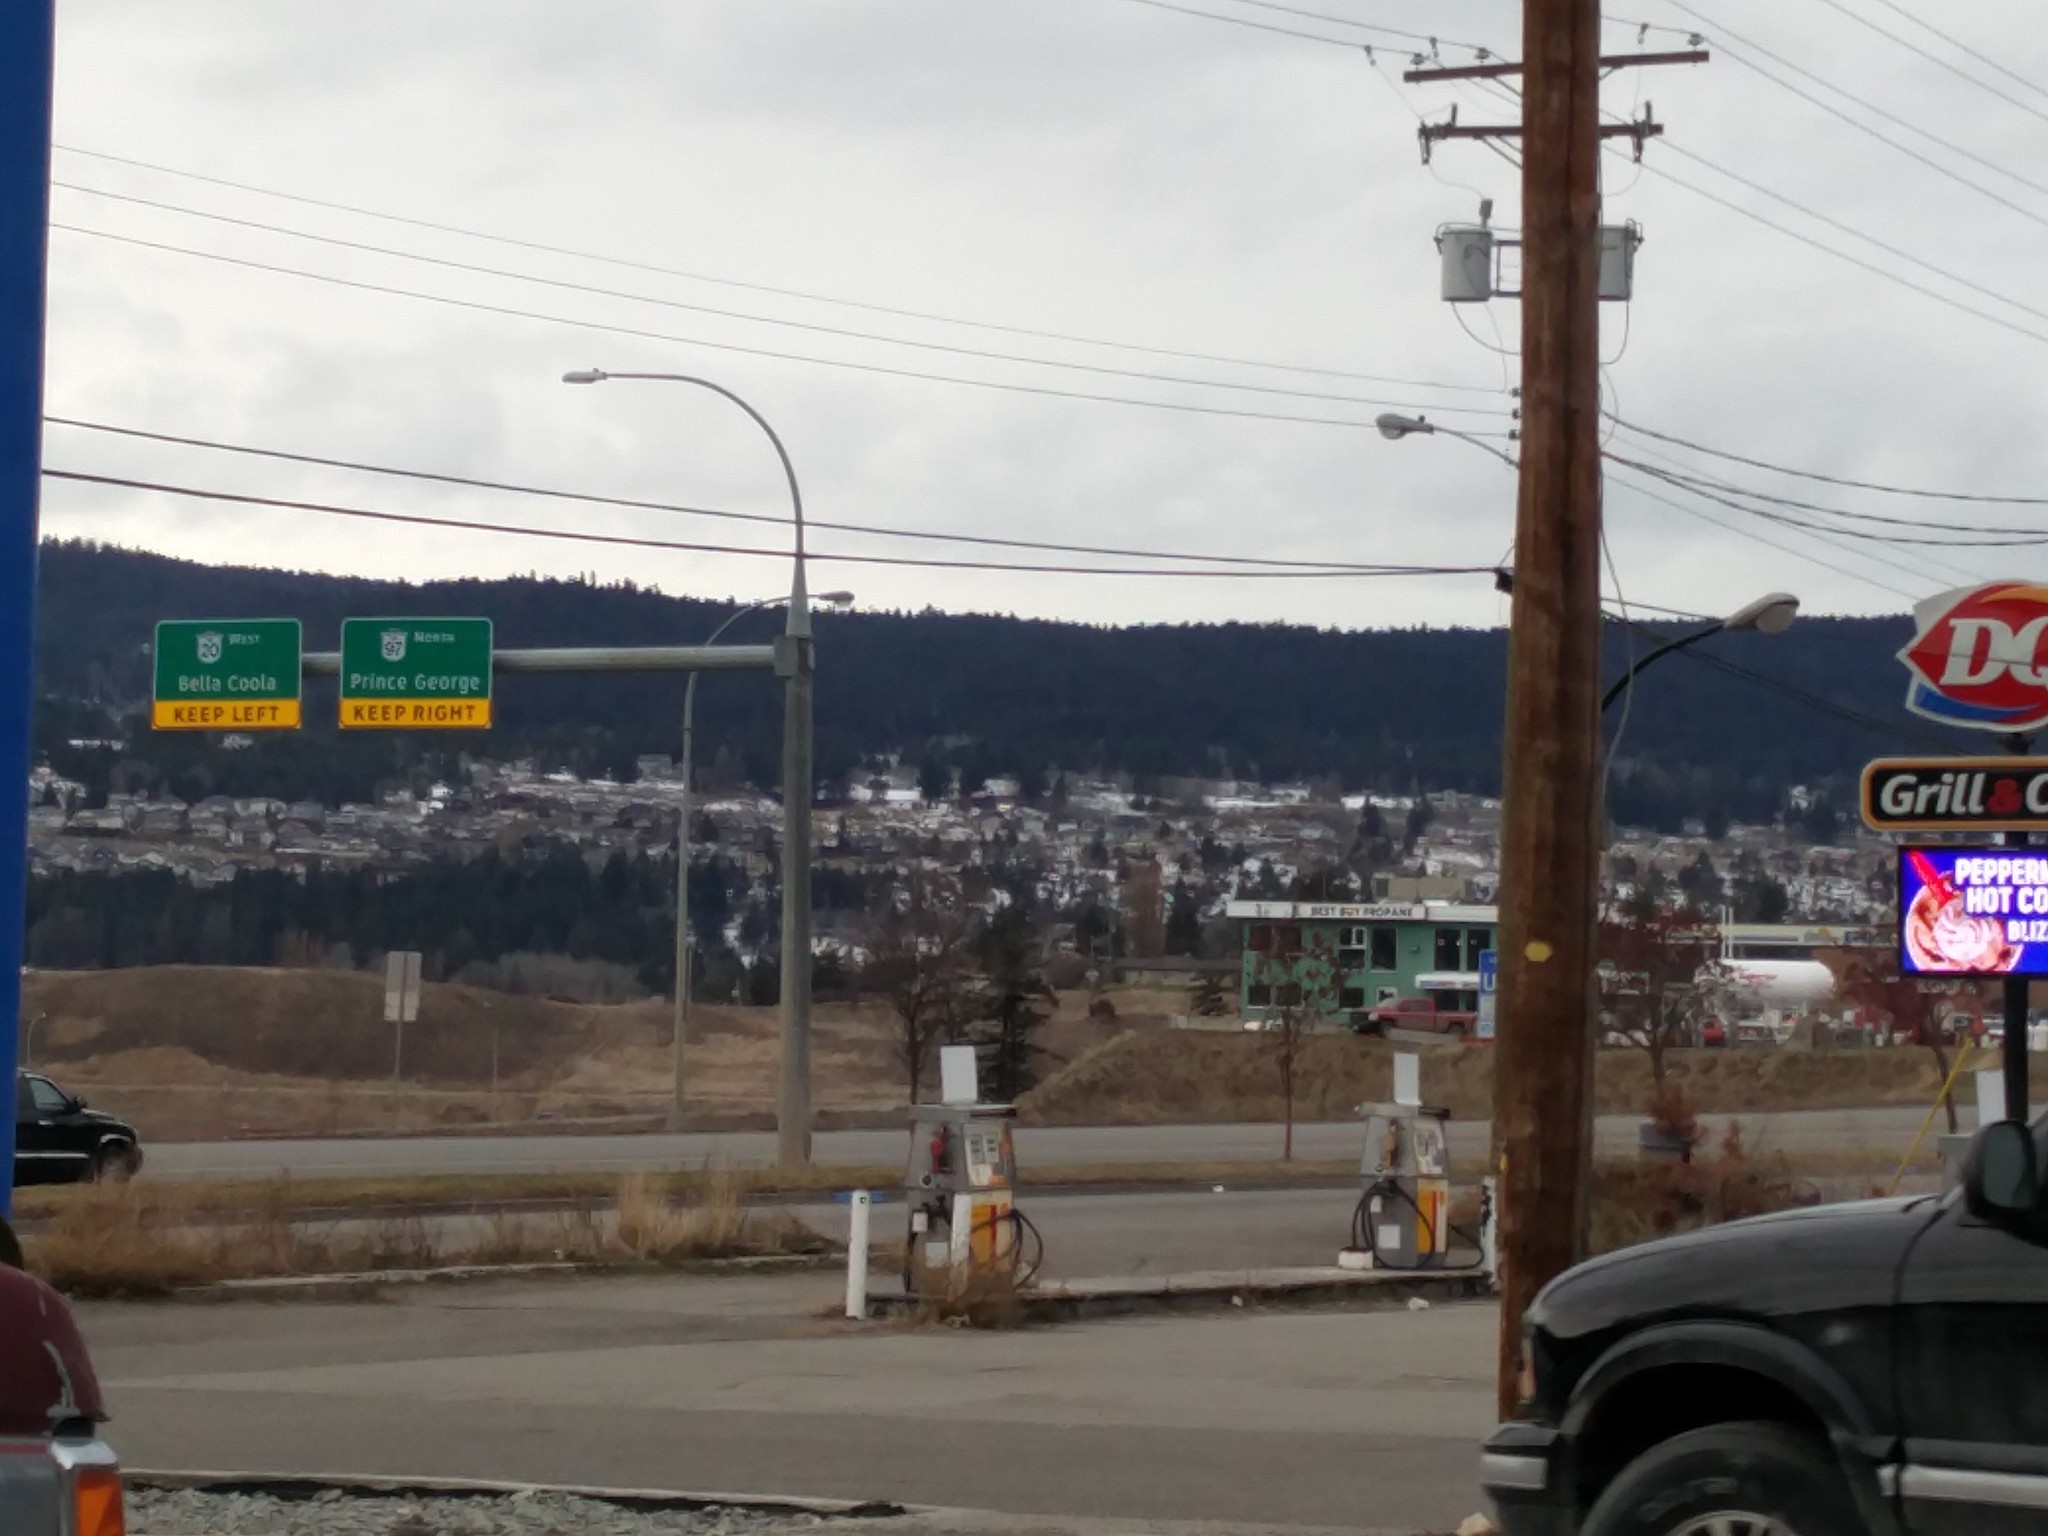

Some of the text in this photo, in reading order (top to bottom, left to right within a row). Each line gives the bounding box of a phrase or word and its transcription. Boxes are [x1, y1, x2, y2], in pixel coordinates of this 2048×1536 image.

[200, 643, 219, 658] 20
[385, 641, 402, 656] 97
[178, 673, 277, 692] Bella Coola
[350, 673, 480, 694] Prince George
[174, 706, 279, 722] KEEP LEFT
[353, 704, 477, 720] KEEP RIGHT
[1880, 772, 1986, 816] Grill
[1966, 886, 2013, 914] HOT
[1312, 906, 1413, 917] BEST BUY PROPANE
